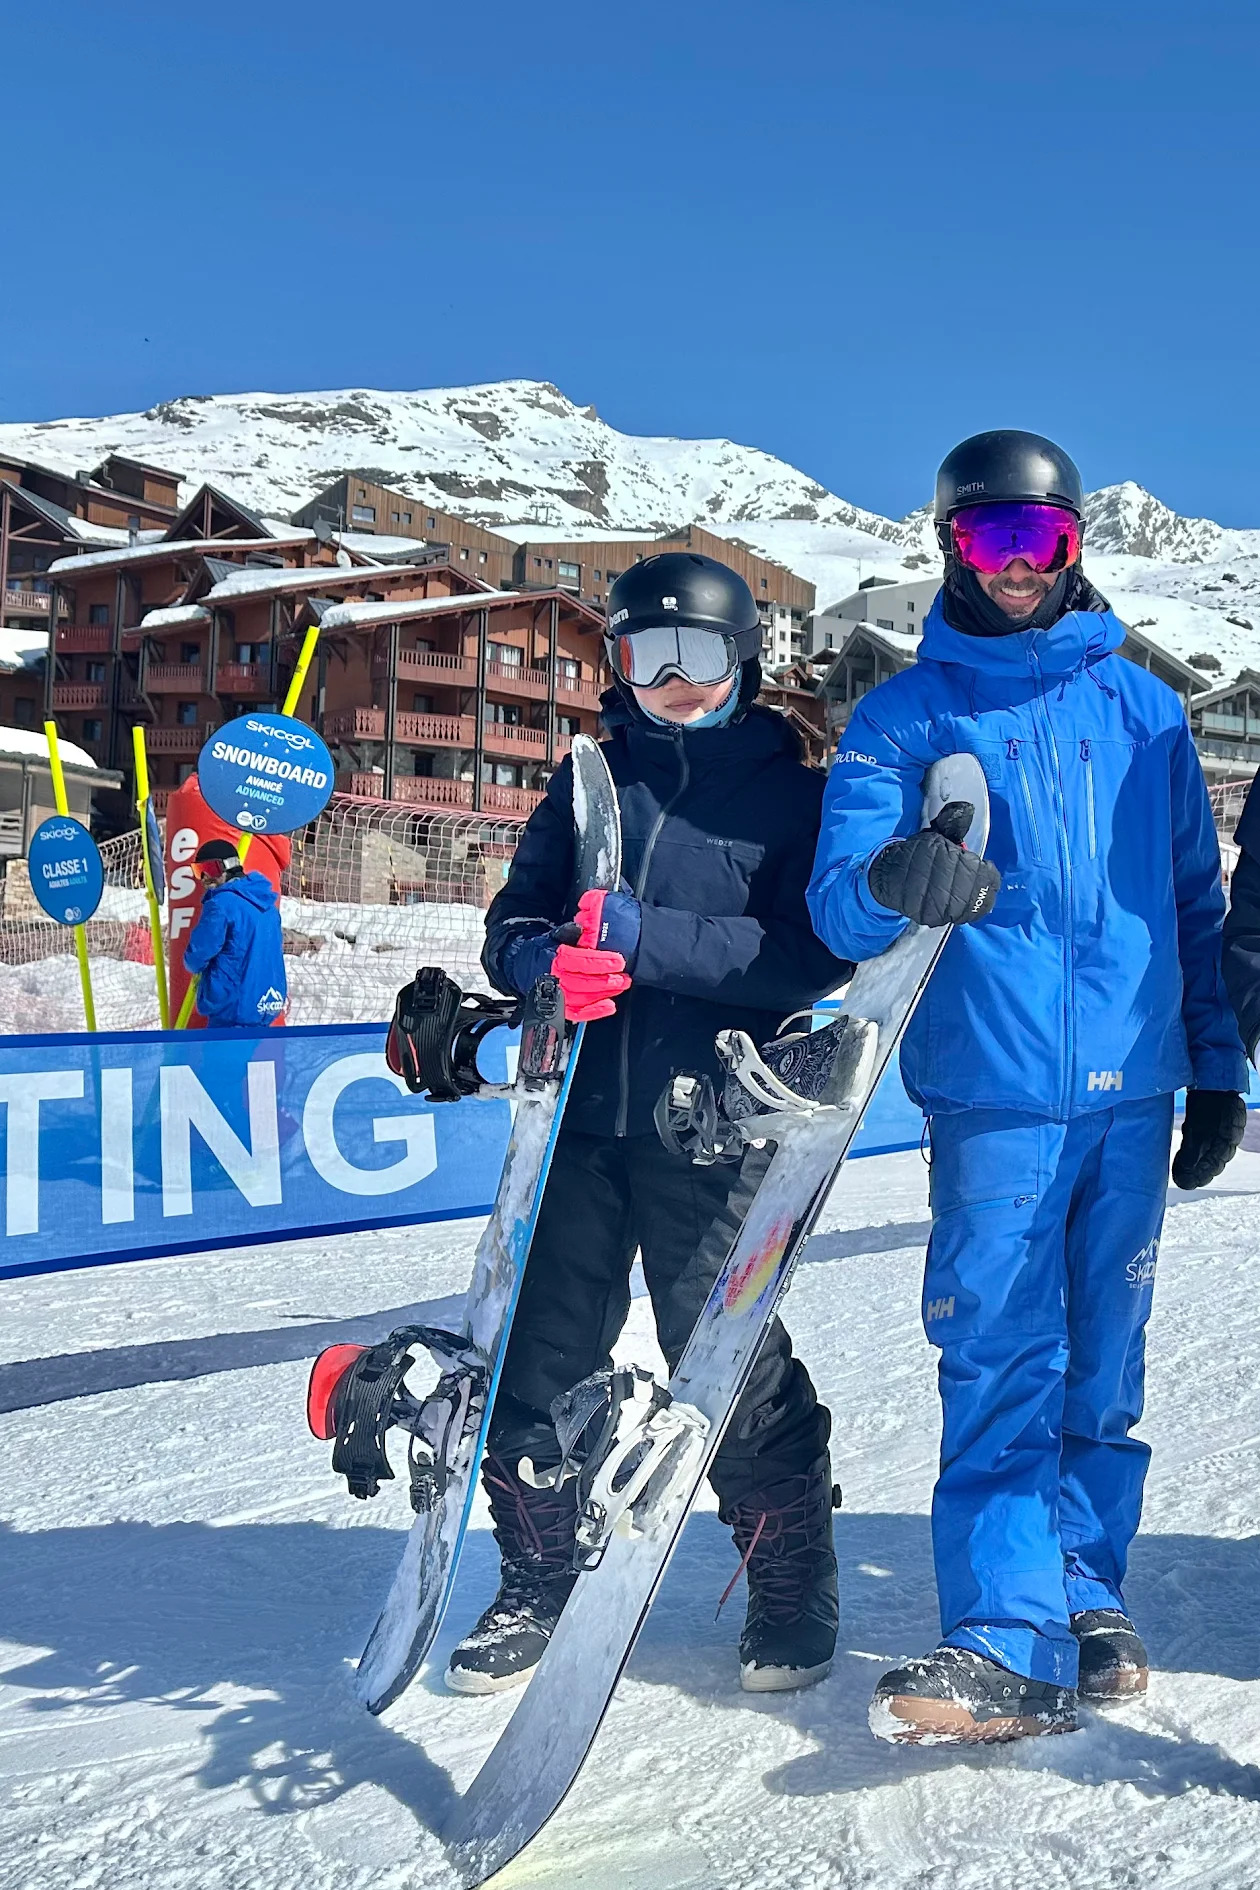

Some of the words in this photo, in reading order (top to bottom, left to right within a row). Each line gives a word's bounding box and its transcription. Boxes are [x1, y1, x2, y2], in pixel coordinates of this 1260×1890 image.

[956, 481, 985, 496] SMITH
[245, 720, 315, 750] SKICOOL
[211, 741, 328, 789] SNOWBOARD
[245, 775, 283, 793] AVANCÉ
[235, 785, 285, 806] ADVANCED
[706, 838, 733, 847] WEDZE
[42, 858, 80, 879] CLASSE
[81, 857, 88, 873] 1
[971, 885, 989, 913] HOWL
[1087, 1070, 1123, 1092] HH
[0, 1051, 438, 1237] TING
[927, 1296, 955, 1322] HH
